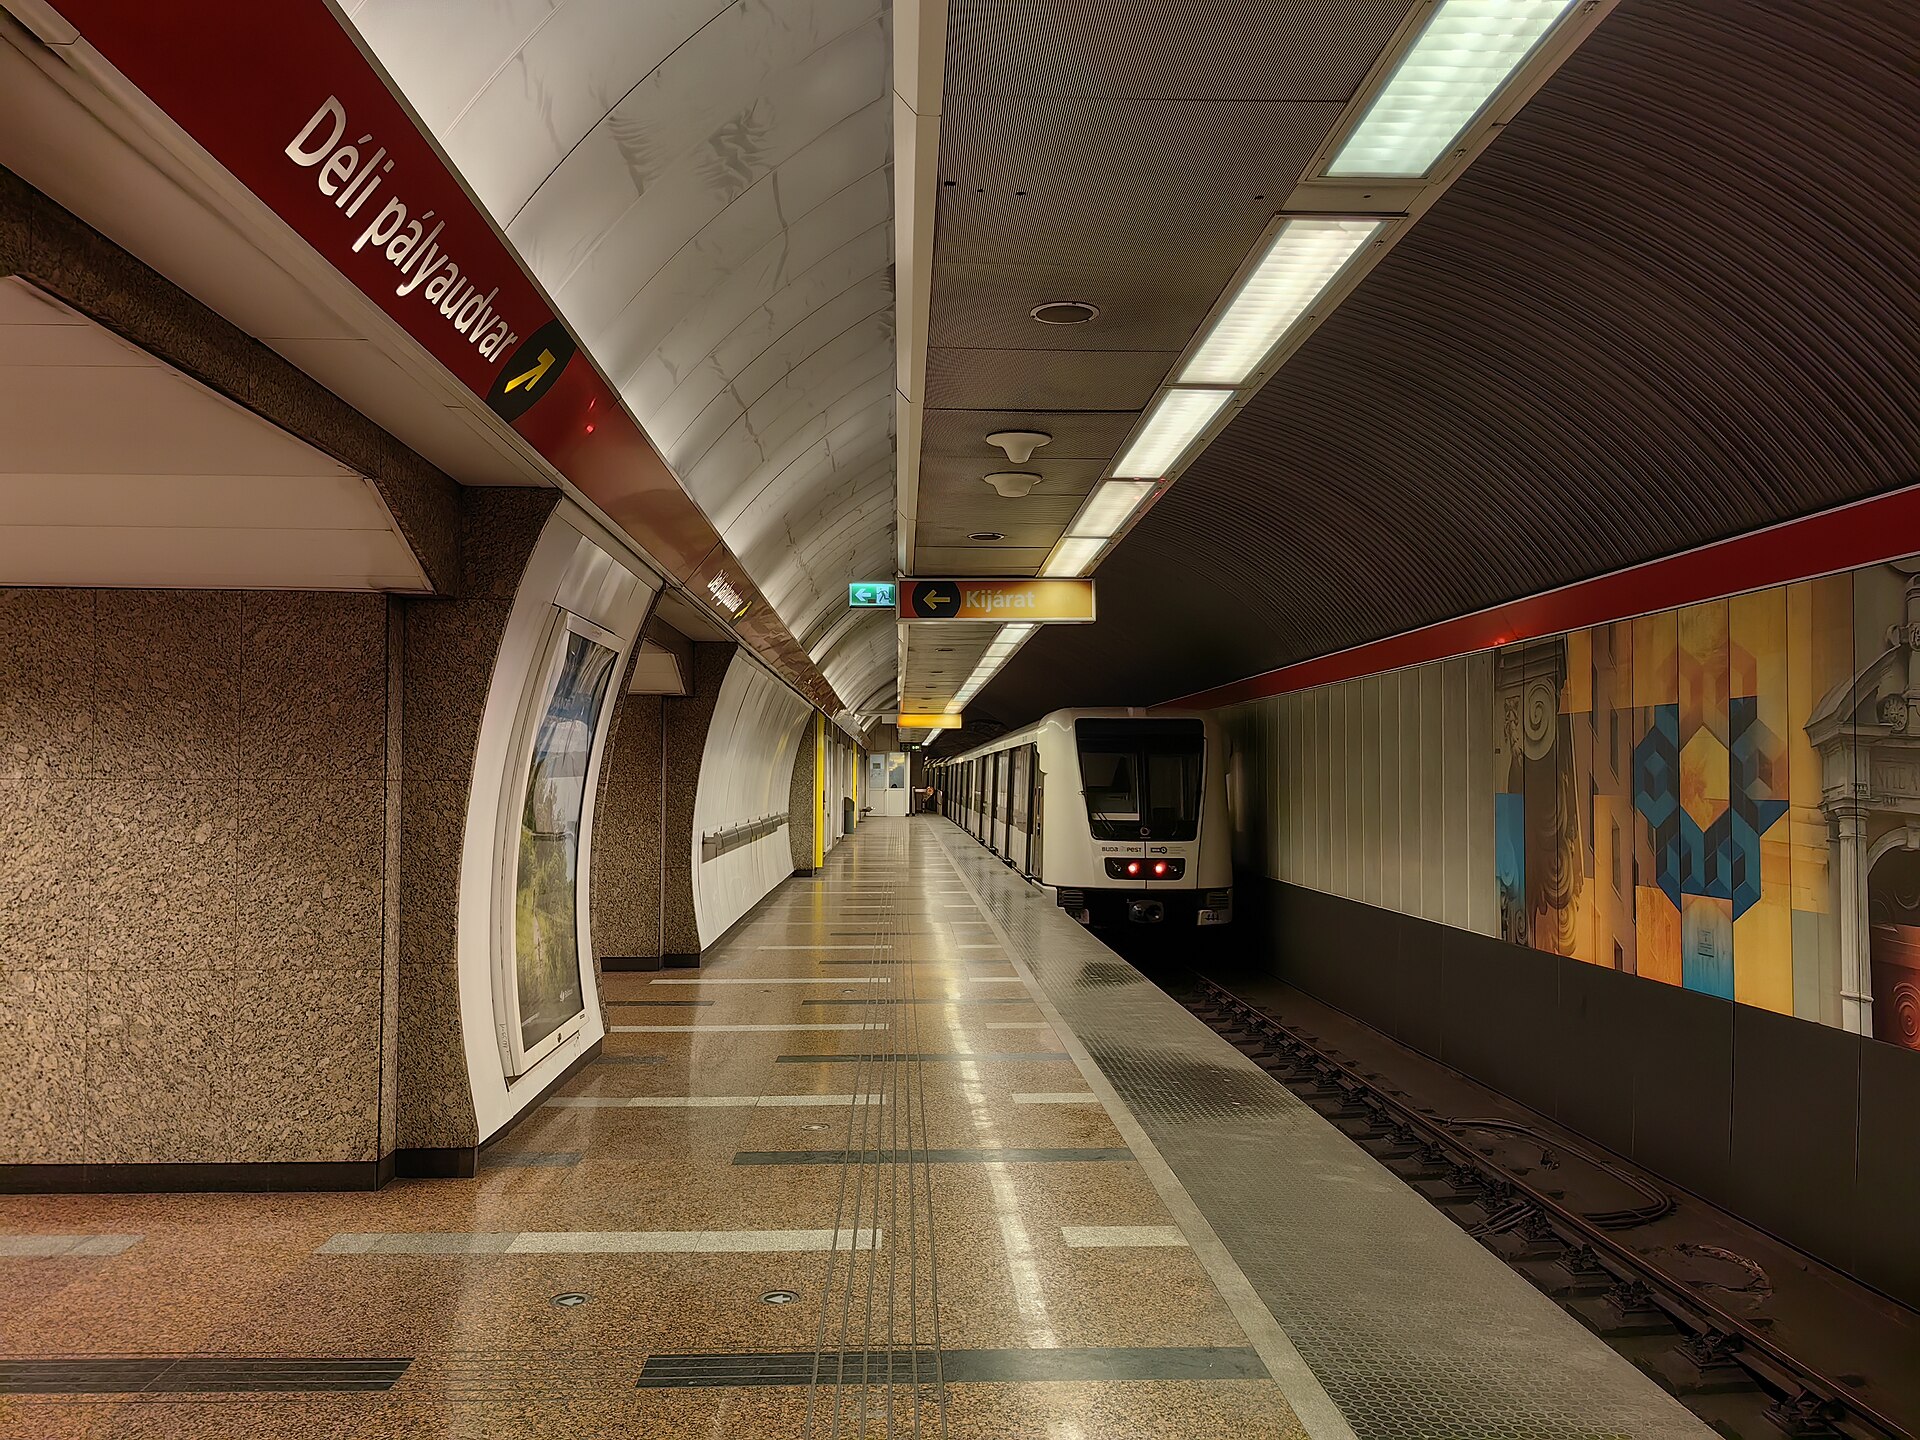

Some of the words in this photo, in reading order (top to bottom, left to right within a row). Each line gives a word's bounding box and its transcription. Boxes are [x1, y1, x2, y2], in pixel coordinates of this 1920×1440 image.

[284, 94, 395, 218] Déli
[351, 196, 519, 363] pályaudvar
[966, 589, 1036, 613] Kijárat
